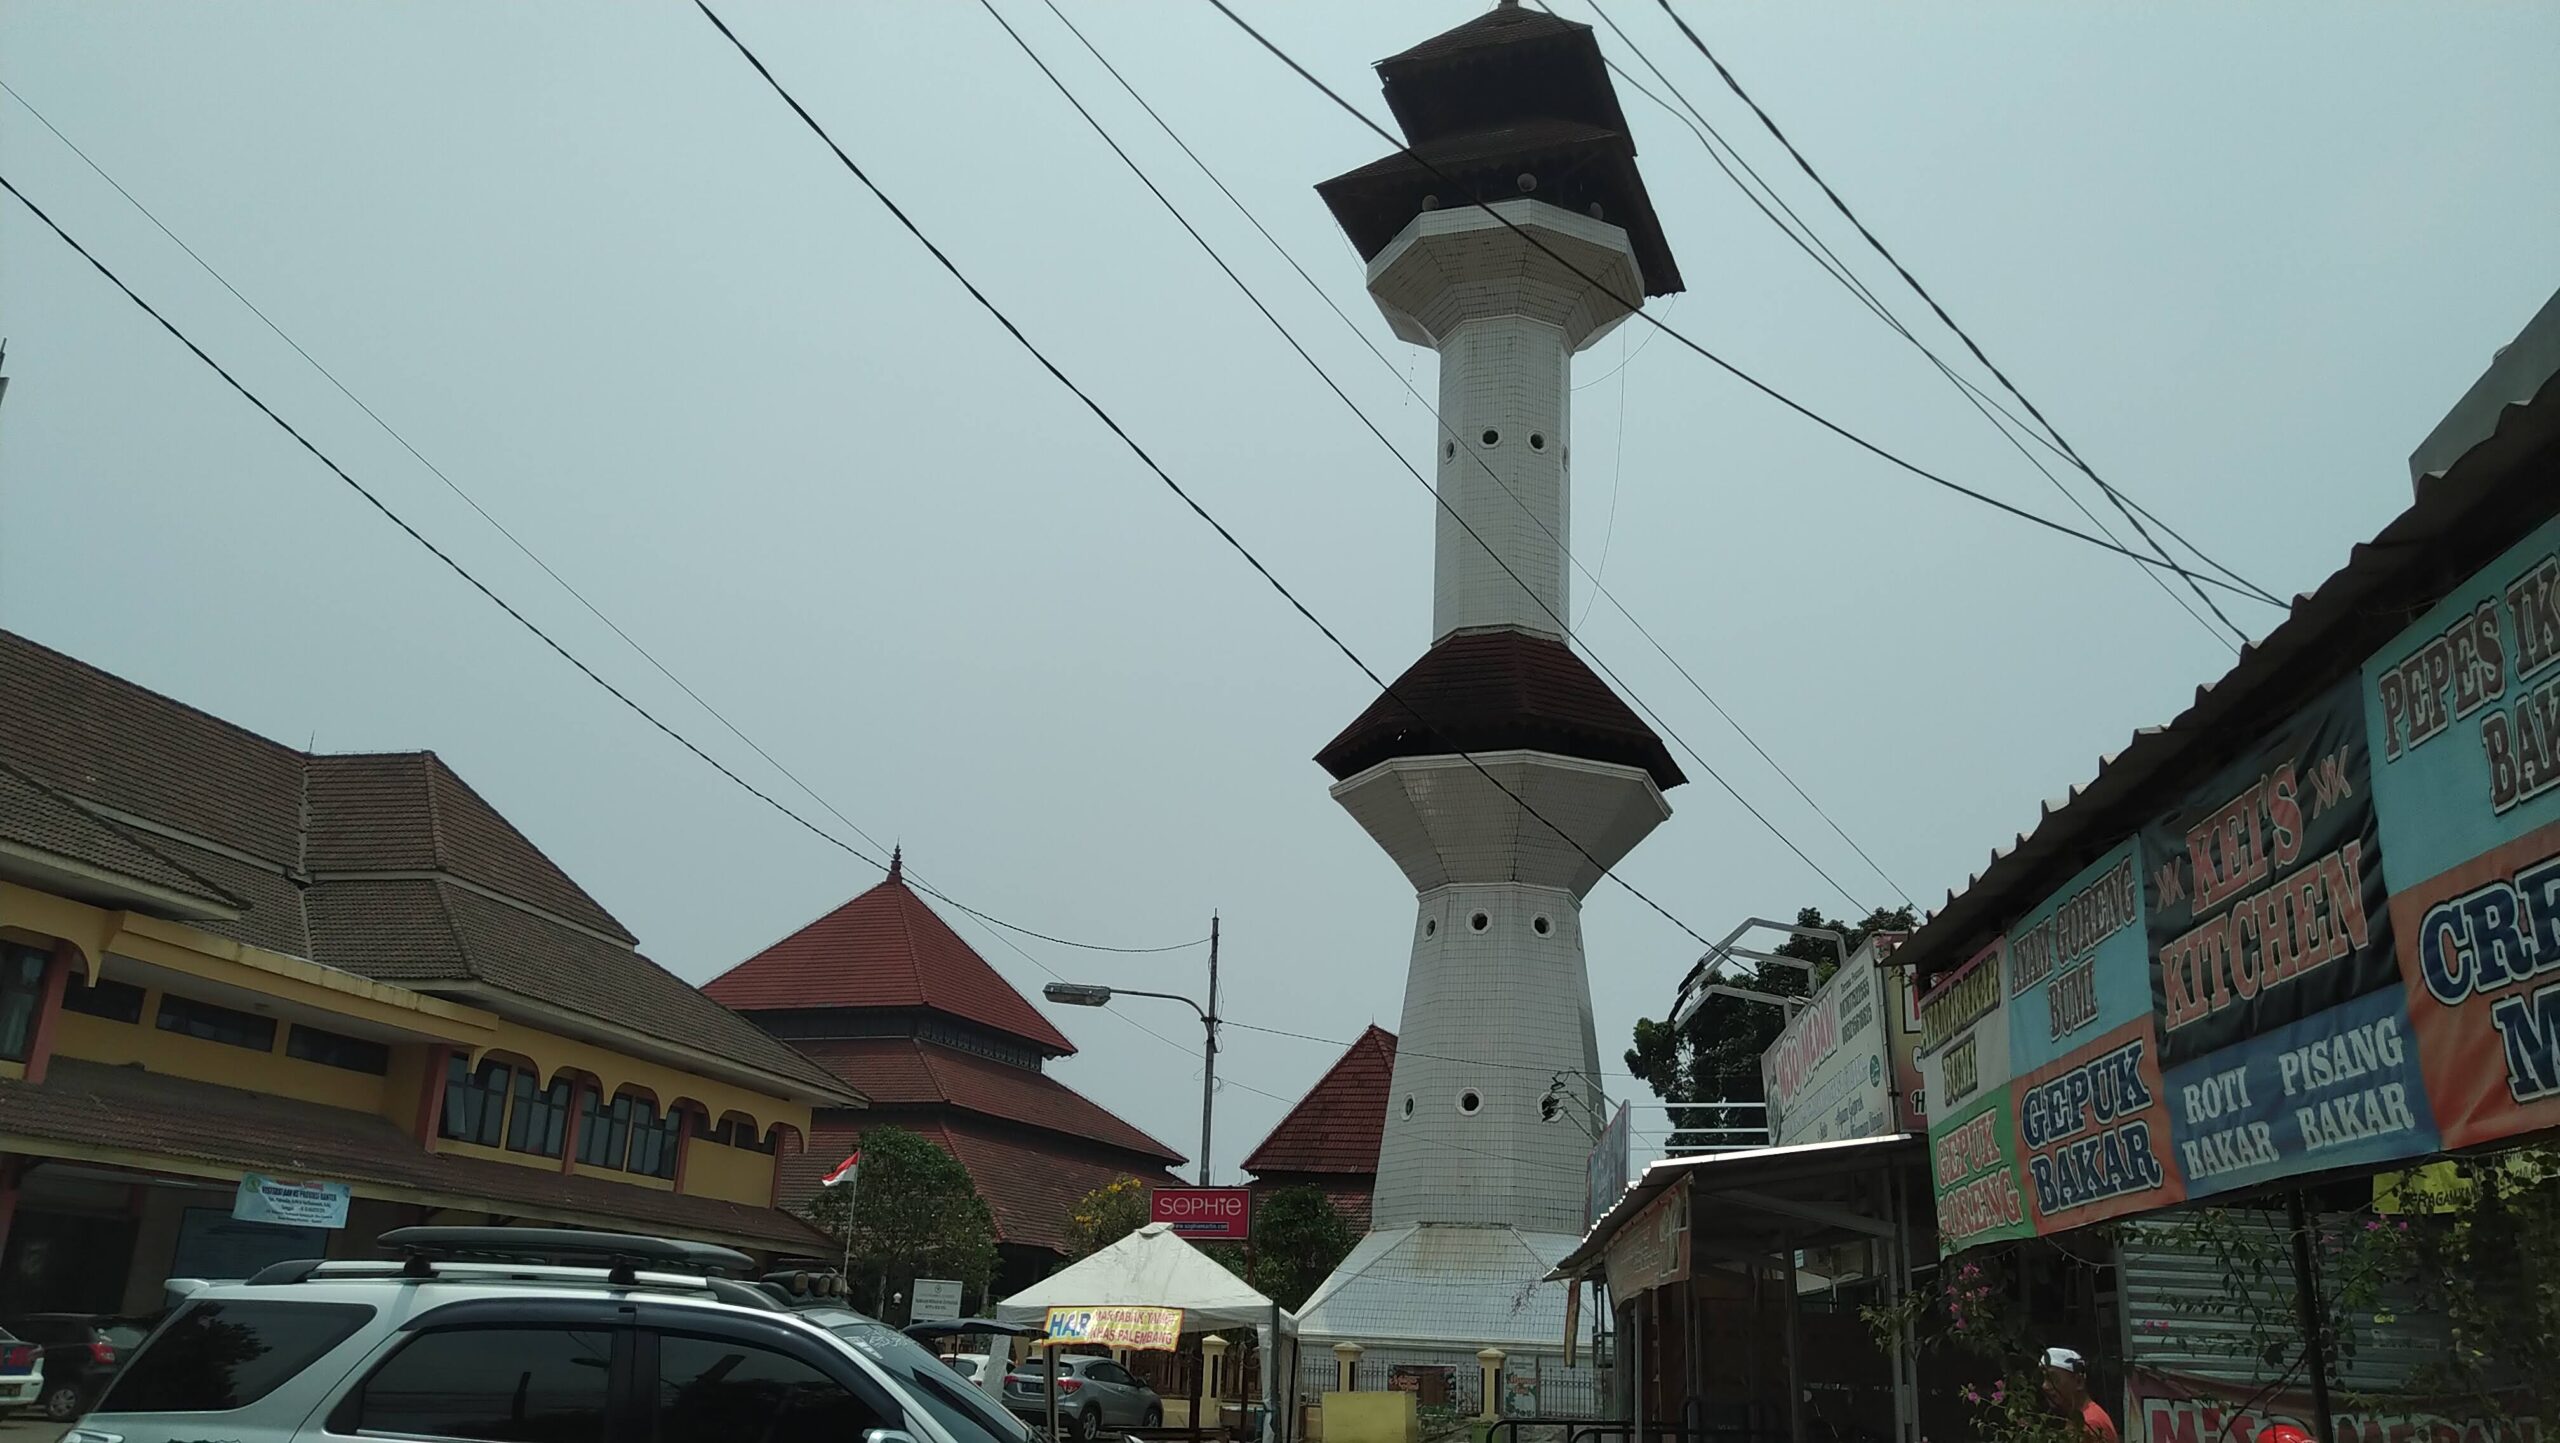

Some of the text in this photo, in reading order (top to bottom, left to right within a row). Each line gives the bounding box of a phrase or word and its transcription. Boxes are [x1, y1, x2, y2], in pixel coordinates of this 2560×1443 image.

[2378, 597, 2506, 764] PEPES
[2186, 758, 2303, 916] KEI'S
[2011, 856, 2136, 999] AYAM GORENG
[2160, 839, 2369, 1032] KITCHEN
[1799, 992, 1837, 1089] MEDAN
[2278, 1016, 2404, 1096] PISANG
[2021, 1042, 2152, 1150] GEPUK
[2183, 1066, 2252, 1124] ROTI
[2297, 1082, 2415, 1151] BAKAR
[1936, 1107, 2001, 1189] GEPUK
[2029, 1120, 2163, 1216] BAKAR
[2182, 1121, 2280, 1180] BAKAR
[1937, 1166, 2022, 1242] GORENG
